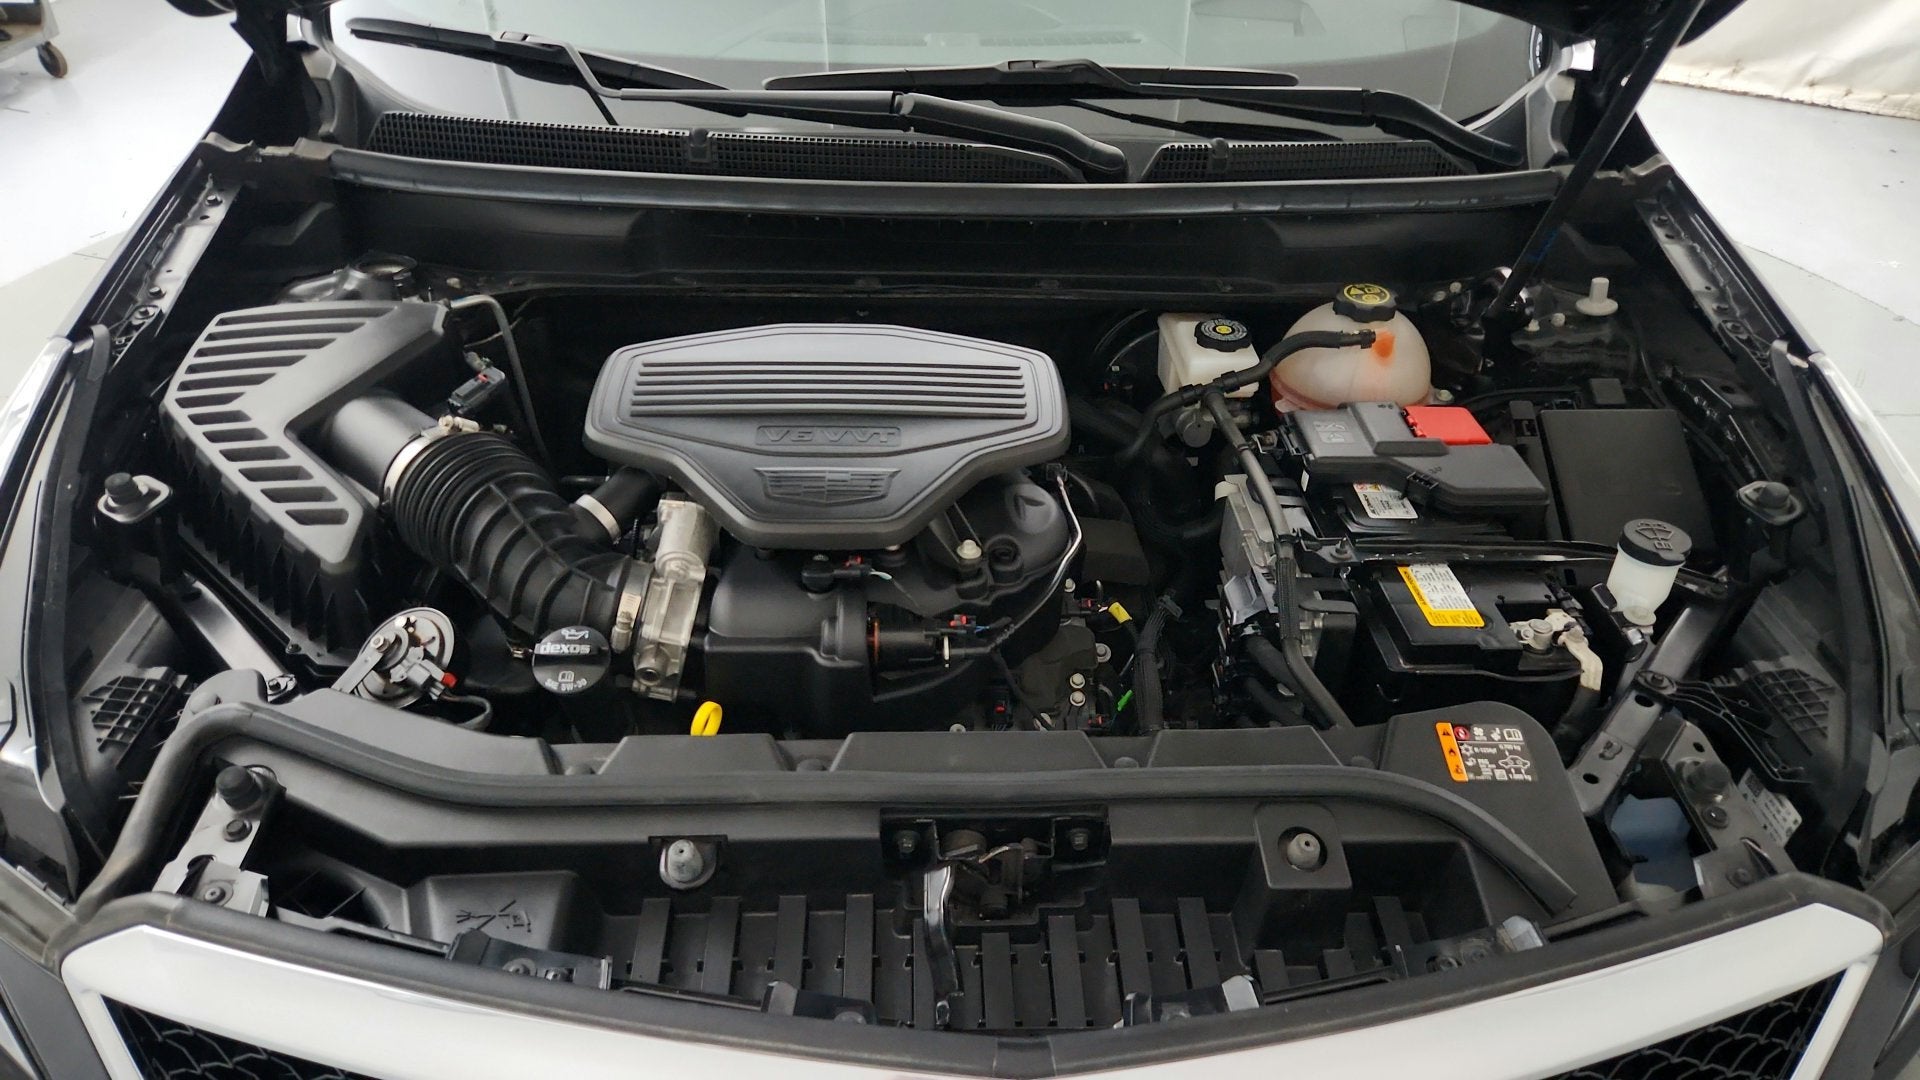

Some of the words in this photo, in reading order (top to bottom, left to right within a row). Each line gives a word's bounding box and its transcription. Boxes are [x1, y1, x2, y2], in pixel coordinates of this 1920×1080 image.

[763, 428, 814, 442] V6
[820, 429, 896, 443] VVT
[539, 642, 591, 655] dexos
